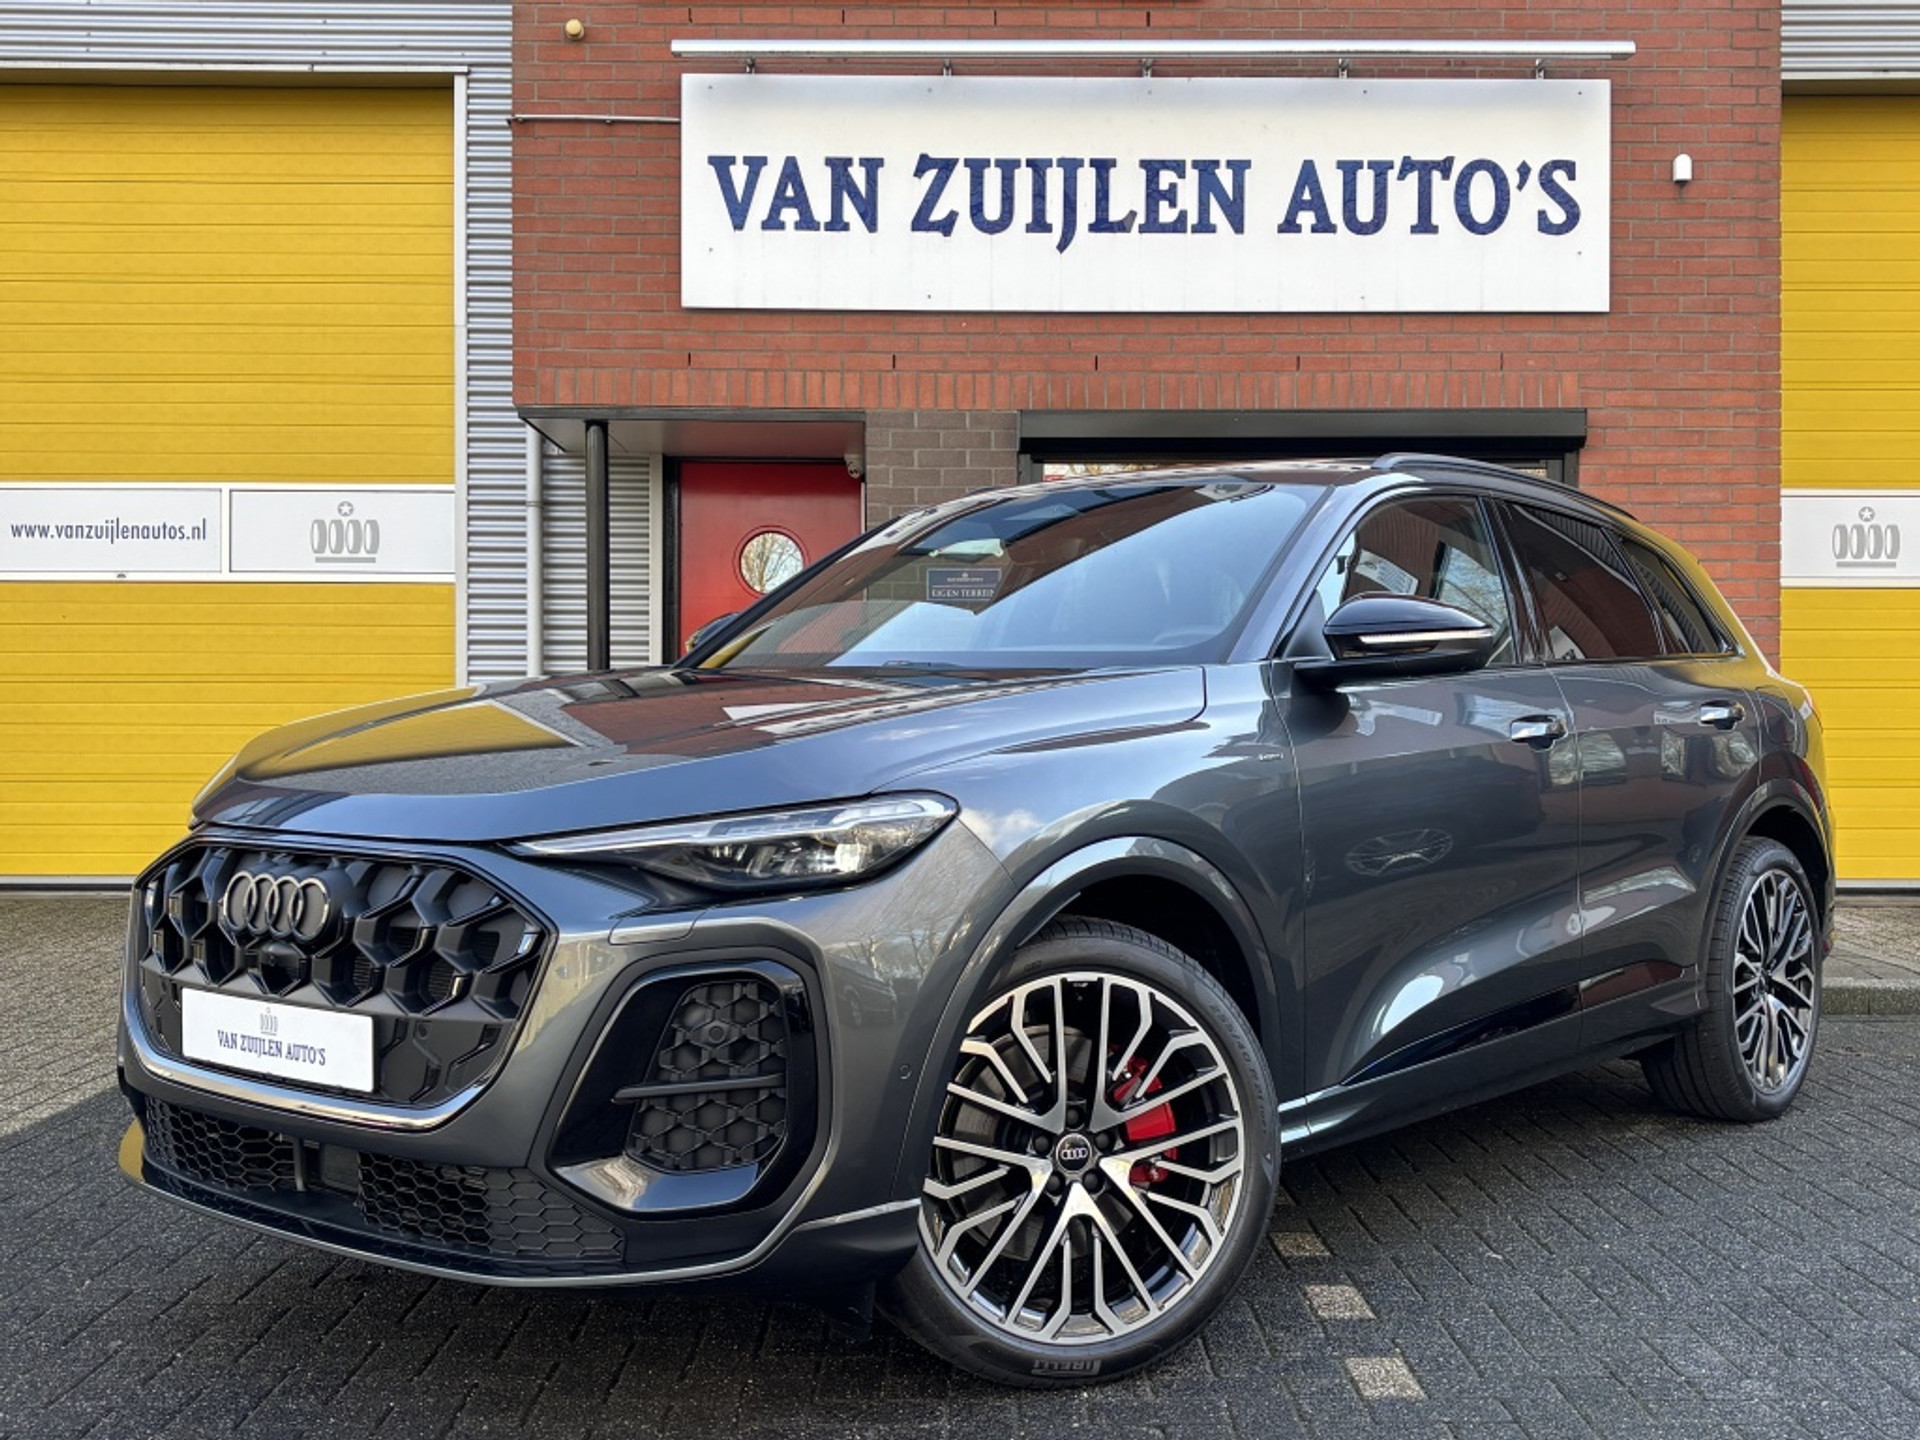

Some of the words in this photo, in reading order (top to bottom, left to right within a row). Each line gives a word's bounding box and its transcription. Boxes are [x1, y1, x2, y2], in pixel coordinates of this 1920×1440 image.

[707, 155, 884, 234] VAN
[911, 153, 1252, 254] ZUIJLEN
[1277, 155, 1581, 236] AUTO'S
[10, 517, 207, 545] www.vanzuijlenautos.nl
[931, 588, 960, 598] EIGEN
[217, 1029, 238, 1050] VAN
[240, 1033, 283, 1058] ZUIJLEN
[285, 1042, 327, 1066] AUTO'S
